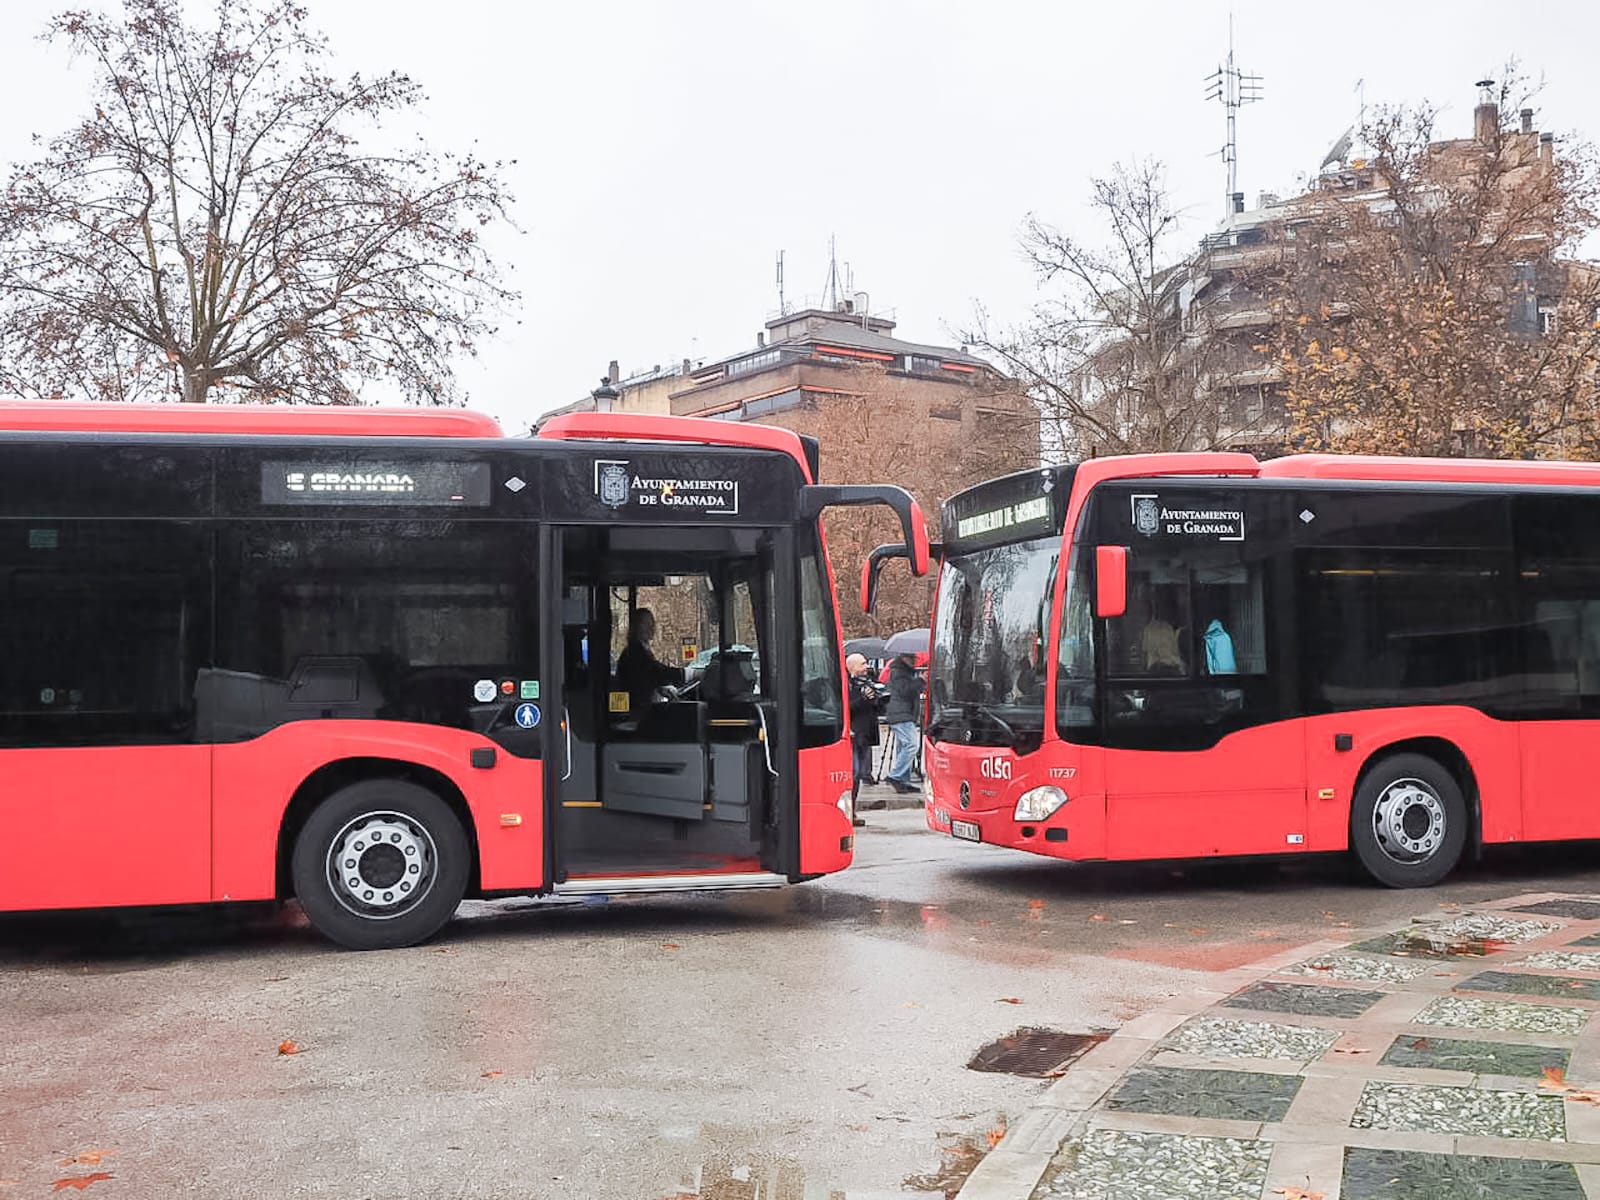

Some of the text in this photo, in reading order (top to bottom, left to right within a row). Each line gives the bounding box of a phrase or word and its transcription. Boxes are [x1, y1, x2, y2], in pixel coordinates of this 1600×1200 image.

[310, 473, 415, 492] GRANADA
[631, 475, 734, 491] AYUNTAMIENTO
[639, 491, 725, 506] DE GRANADA
[1160, 507, 1240, 520] AYUNTAMIENTO
[1166, 521, 1234, 534] DE GRANADA
[830, 770, 852, 783] 1173
[1049, 768, 1077, 779] 11737
